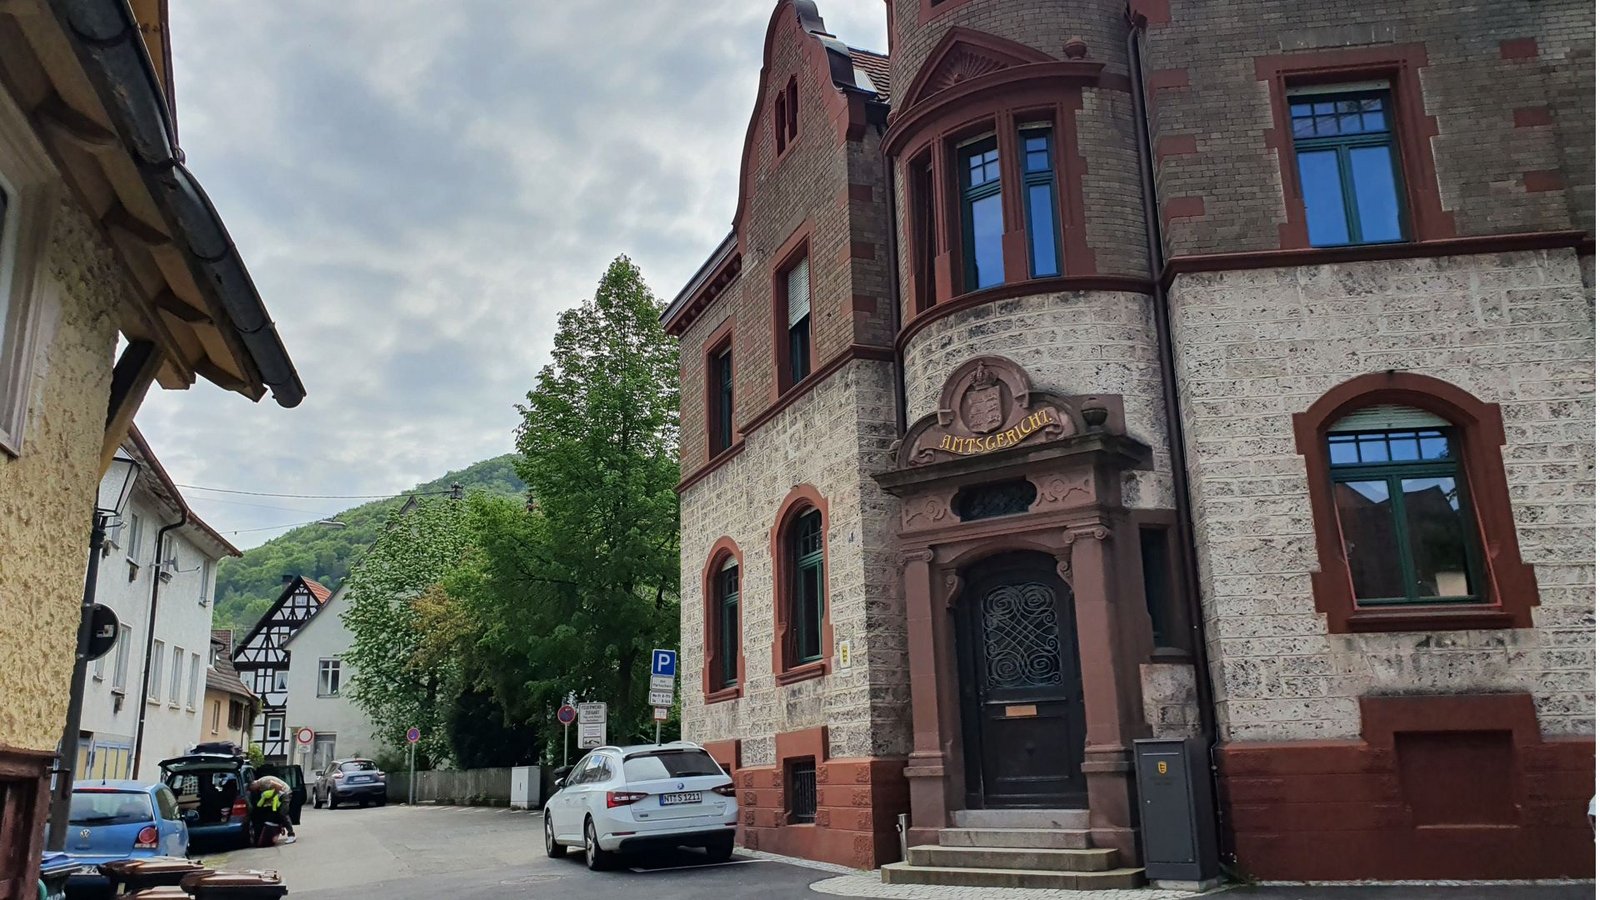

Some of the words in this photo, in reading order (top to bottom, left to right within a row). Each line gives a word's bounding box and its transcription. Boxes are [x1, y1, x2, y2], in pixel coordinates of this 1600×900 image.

[657, 653, 671, 672] P
[677, 793, 683, 802] S
[683, 792, 701, 802] 1211
